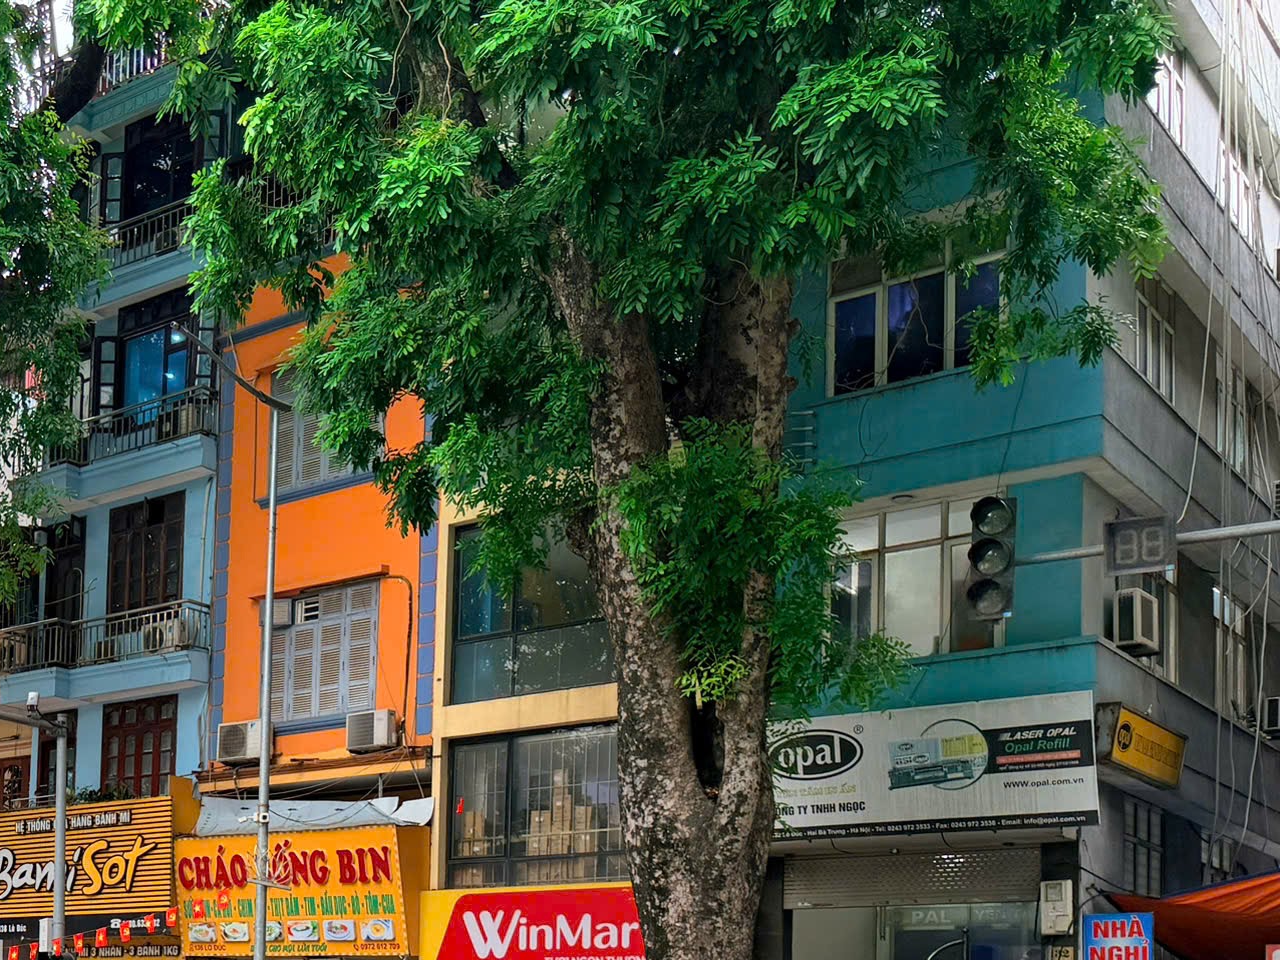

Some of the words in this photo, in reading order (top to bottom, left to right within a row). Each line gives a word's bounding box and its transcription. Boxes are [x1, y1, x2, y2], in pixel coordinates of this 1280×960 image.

[1006, 729, 1044, 741] LASER
[1046, 726, 1077, 737] OPAL
[1004, 741, 1034, 754] Opal
[1036, 737, 1070, 750] Refill
[797, 805, 808, 815] TY
[810, 803, 836, 814] TNHH
[838, 801, 866, 814] NGỌC
[336, 845, 394, 886] BIN
[461, 908, 641, 960] WinMar
[1092, 914, 1145, 939] NHÀ
[129, 946, 135, 957] 3
[163, 945, 179, 956] 1KG
